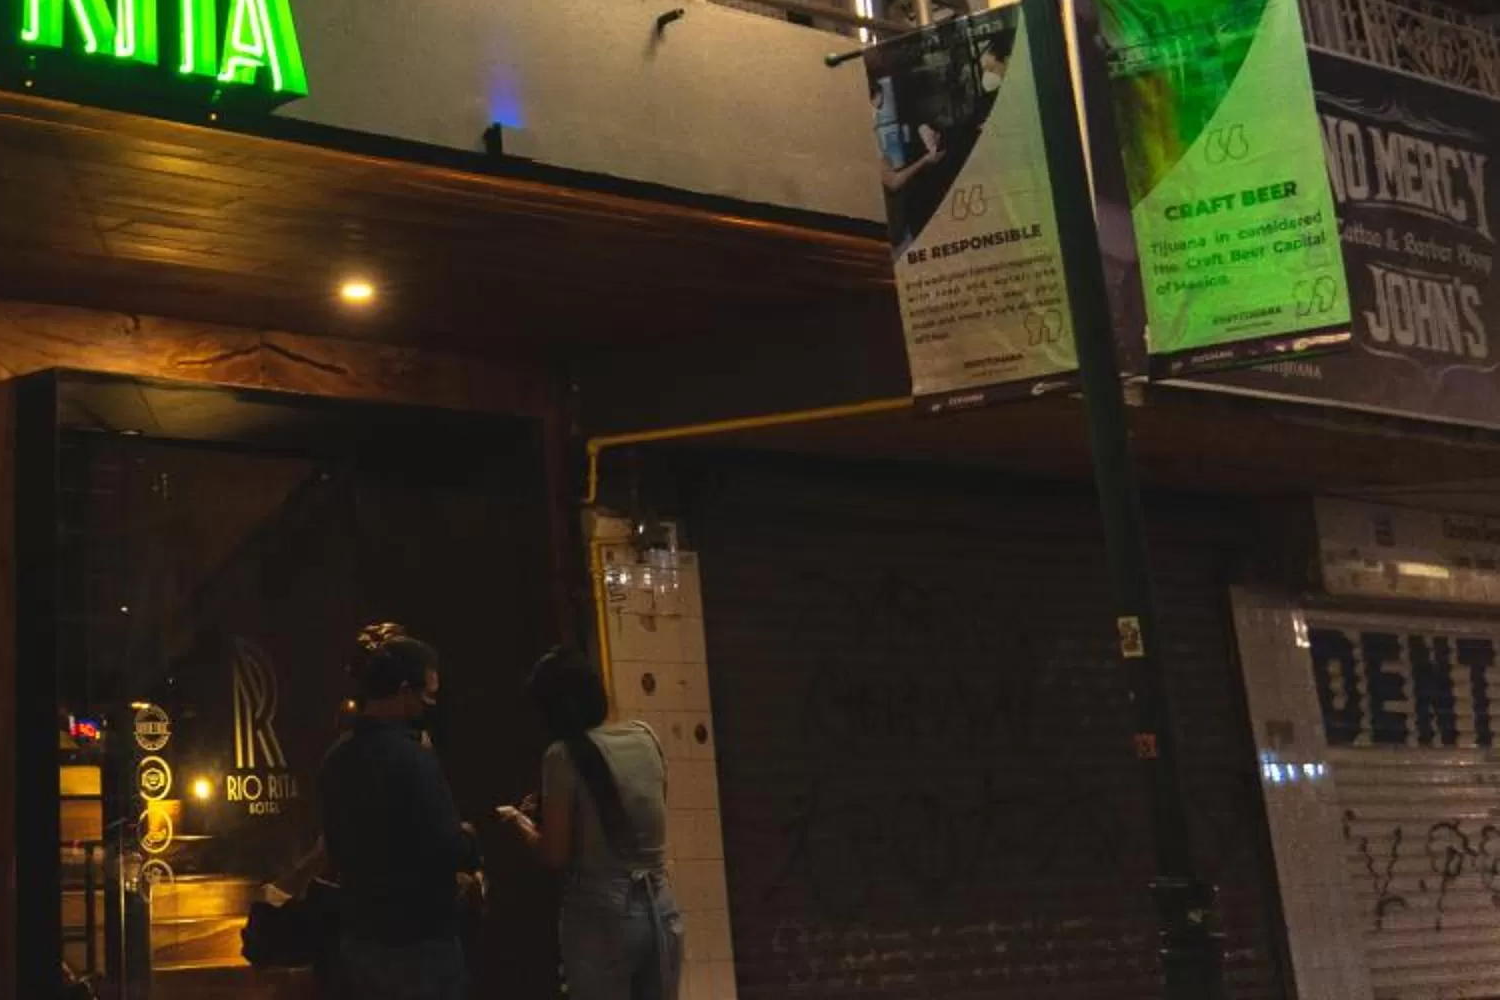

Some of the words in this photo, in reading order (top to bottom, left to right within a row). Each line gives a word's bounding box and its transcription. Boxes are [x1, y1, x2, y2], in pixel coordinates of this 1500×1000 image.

[1320, 114, 1369, 203] NO
[1367, 125, 1496, 244] MERCY
[1164, 193, 1236, 221] CRAFT
[1241, 180, 1297, 206] BEER
[907, 249, 927, 265] BE
[932, 223, 1042, 259] RESPONSIBLE
[1152, 235, 1206, 257] Tijuana
[1237, 209, 1323, 240] considered
[1186, 252, 1223, 270] Craft
[1230, 246, 1265, 263] Beer
[1273, 231, 1326, 254] Capital
[1363, 263, 1489, 358] JOHN'S
[227, 774, 262, 801] RIO
[268, 773, 299, 801] RITA
